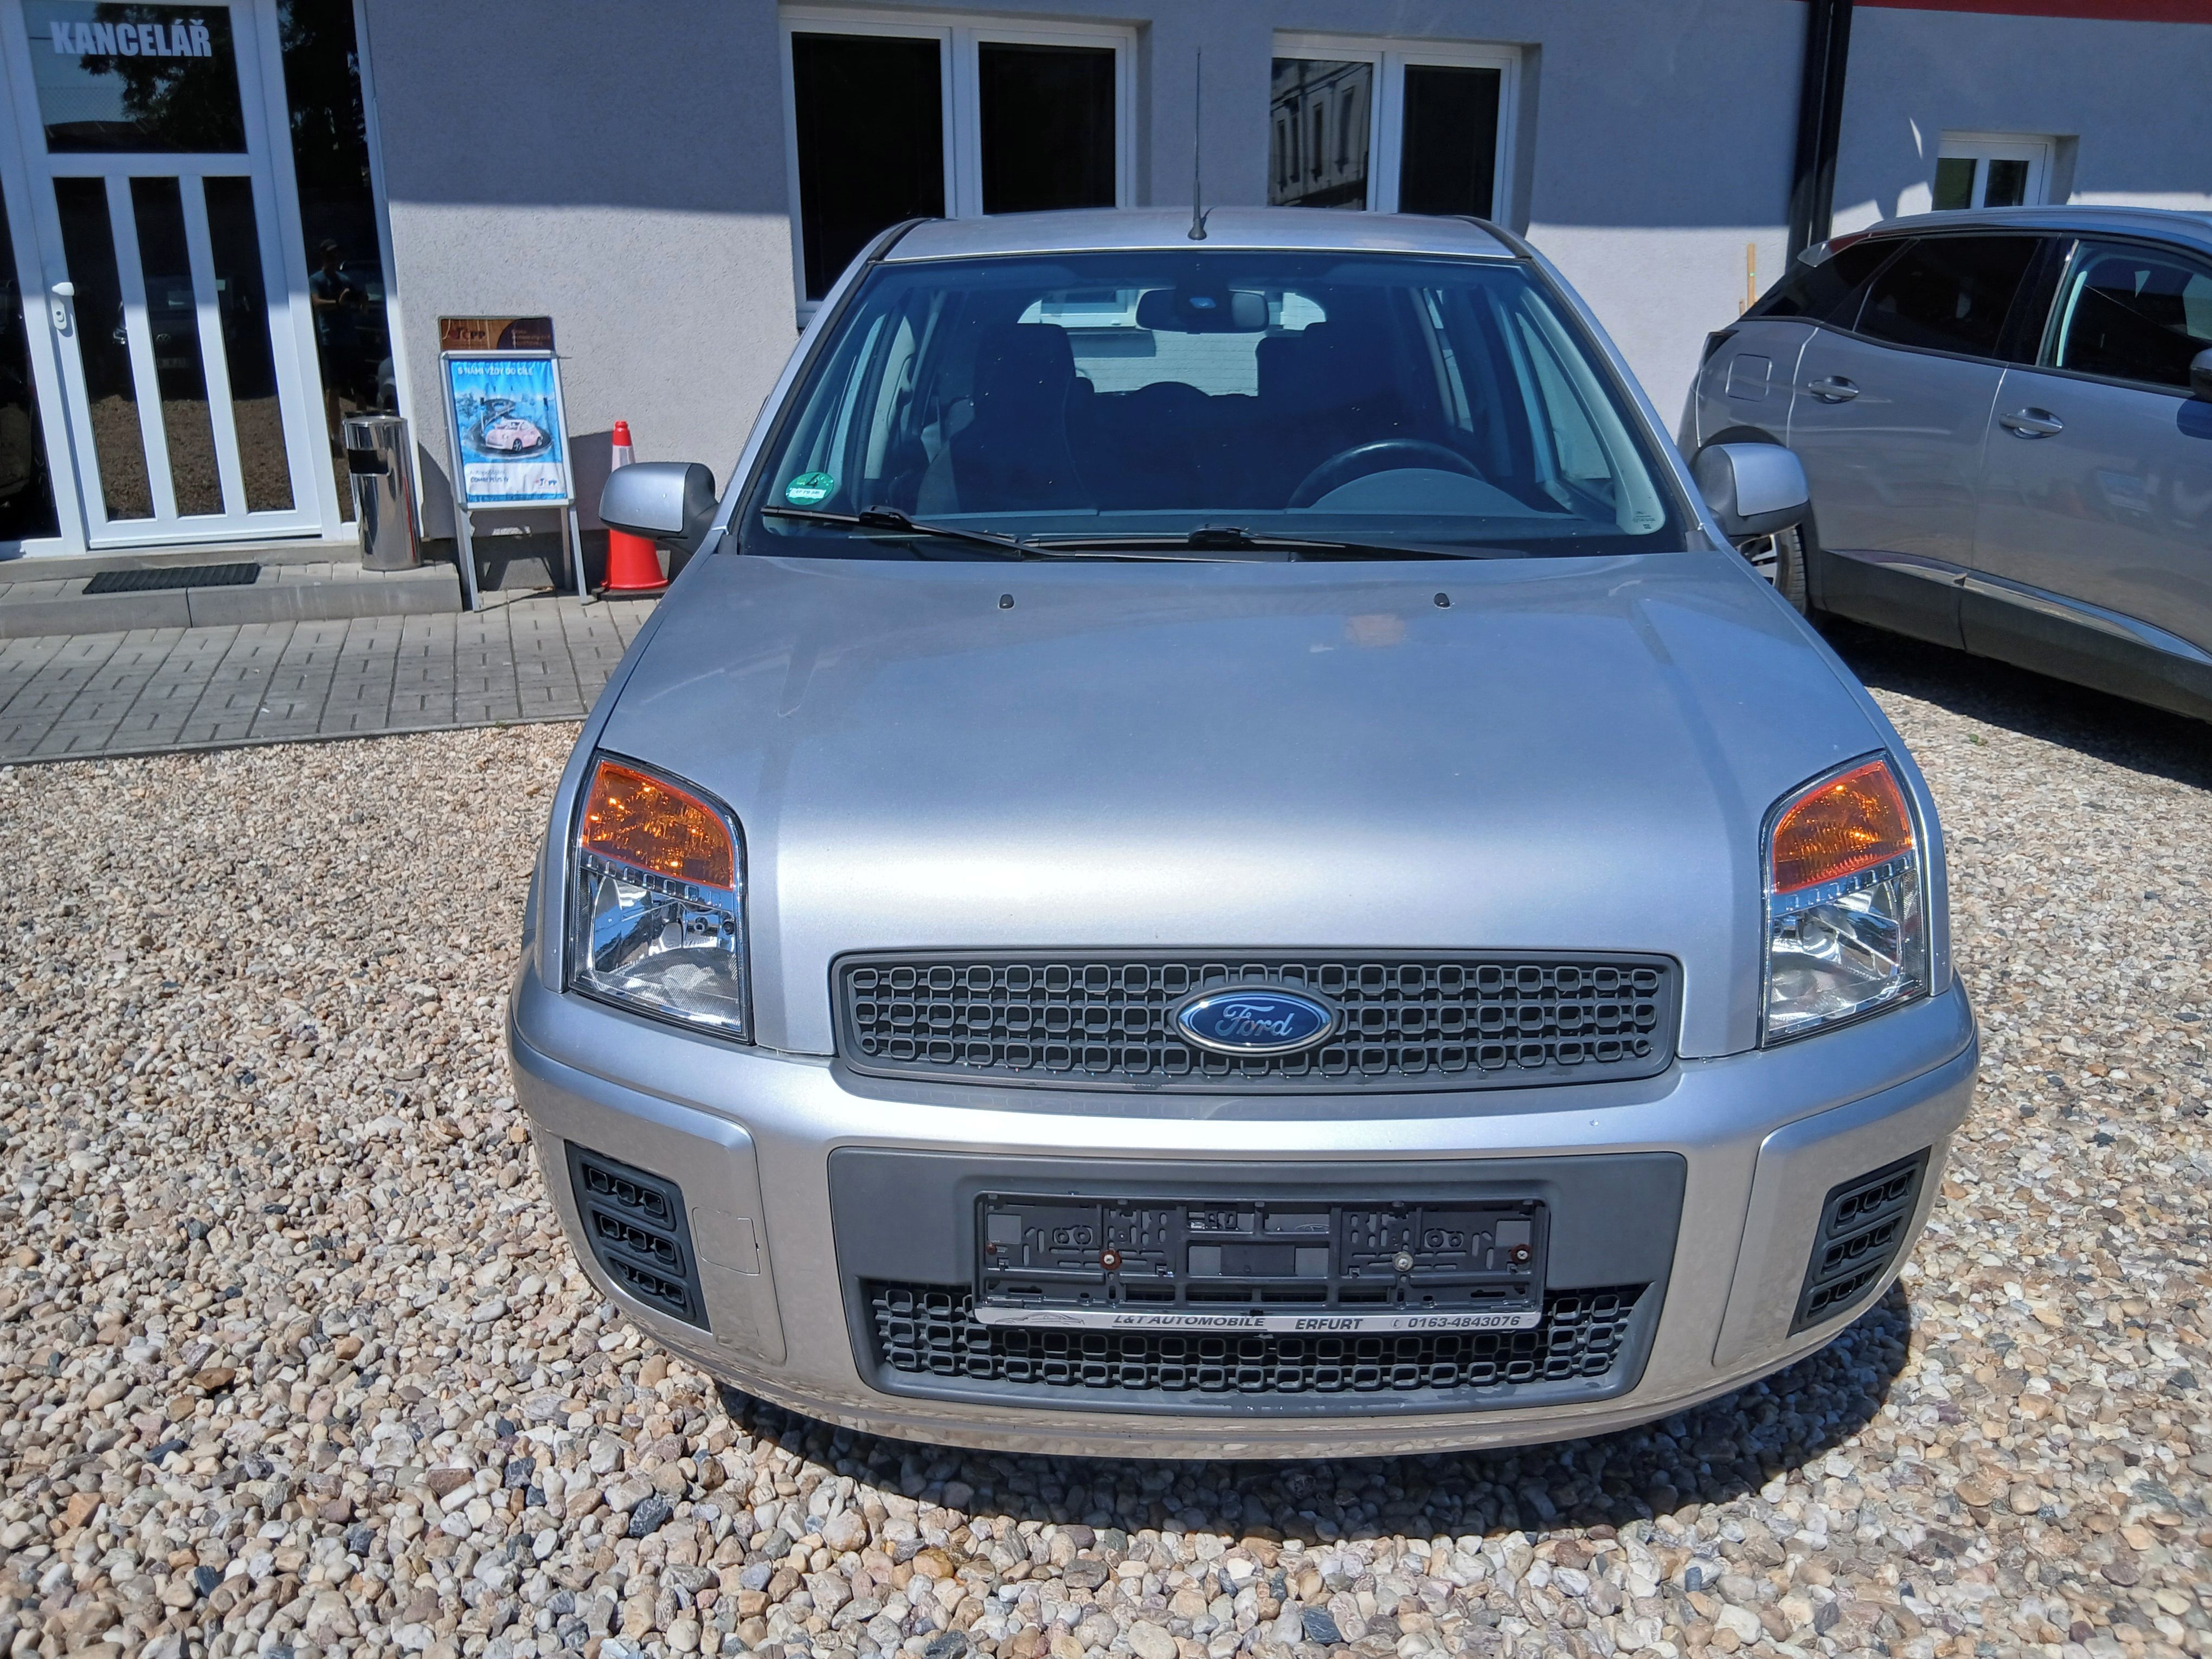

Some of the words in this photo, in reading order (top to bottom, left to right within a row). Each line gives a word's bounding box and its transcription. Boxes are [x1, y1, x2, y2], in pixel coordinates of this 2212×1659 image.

[50, 19, 212, 57] KANCELÁŘ
[505, 366, 516, 375] DO
[805, 473, 820, 488] 4
[1214, 1004, 1295, 1037] Ford
[1113, 1315, 1147, 1324] L&T
[1147, 1316, 1266, 1327] AUTOMOBILE
[1295, 1319, 1364, 1330] ERFURT
[1407, 1316, 1521, 1328] 0163-4843076
